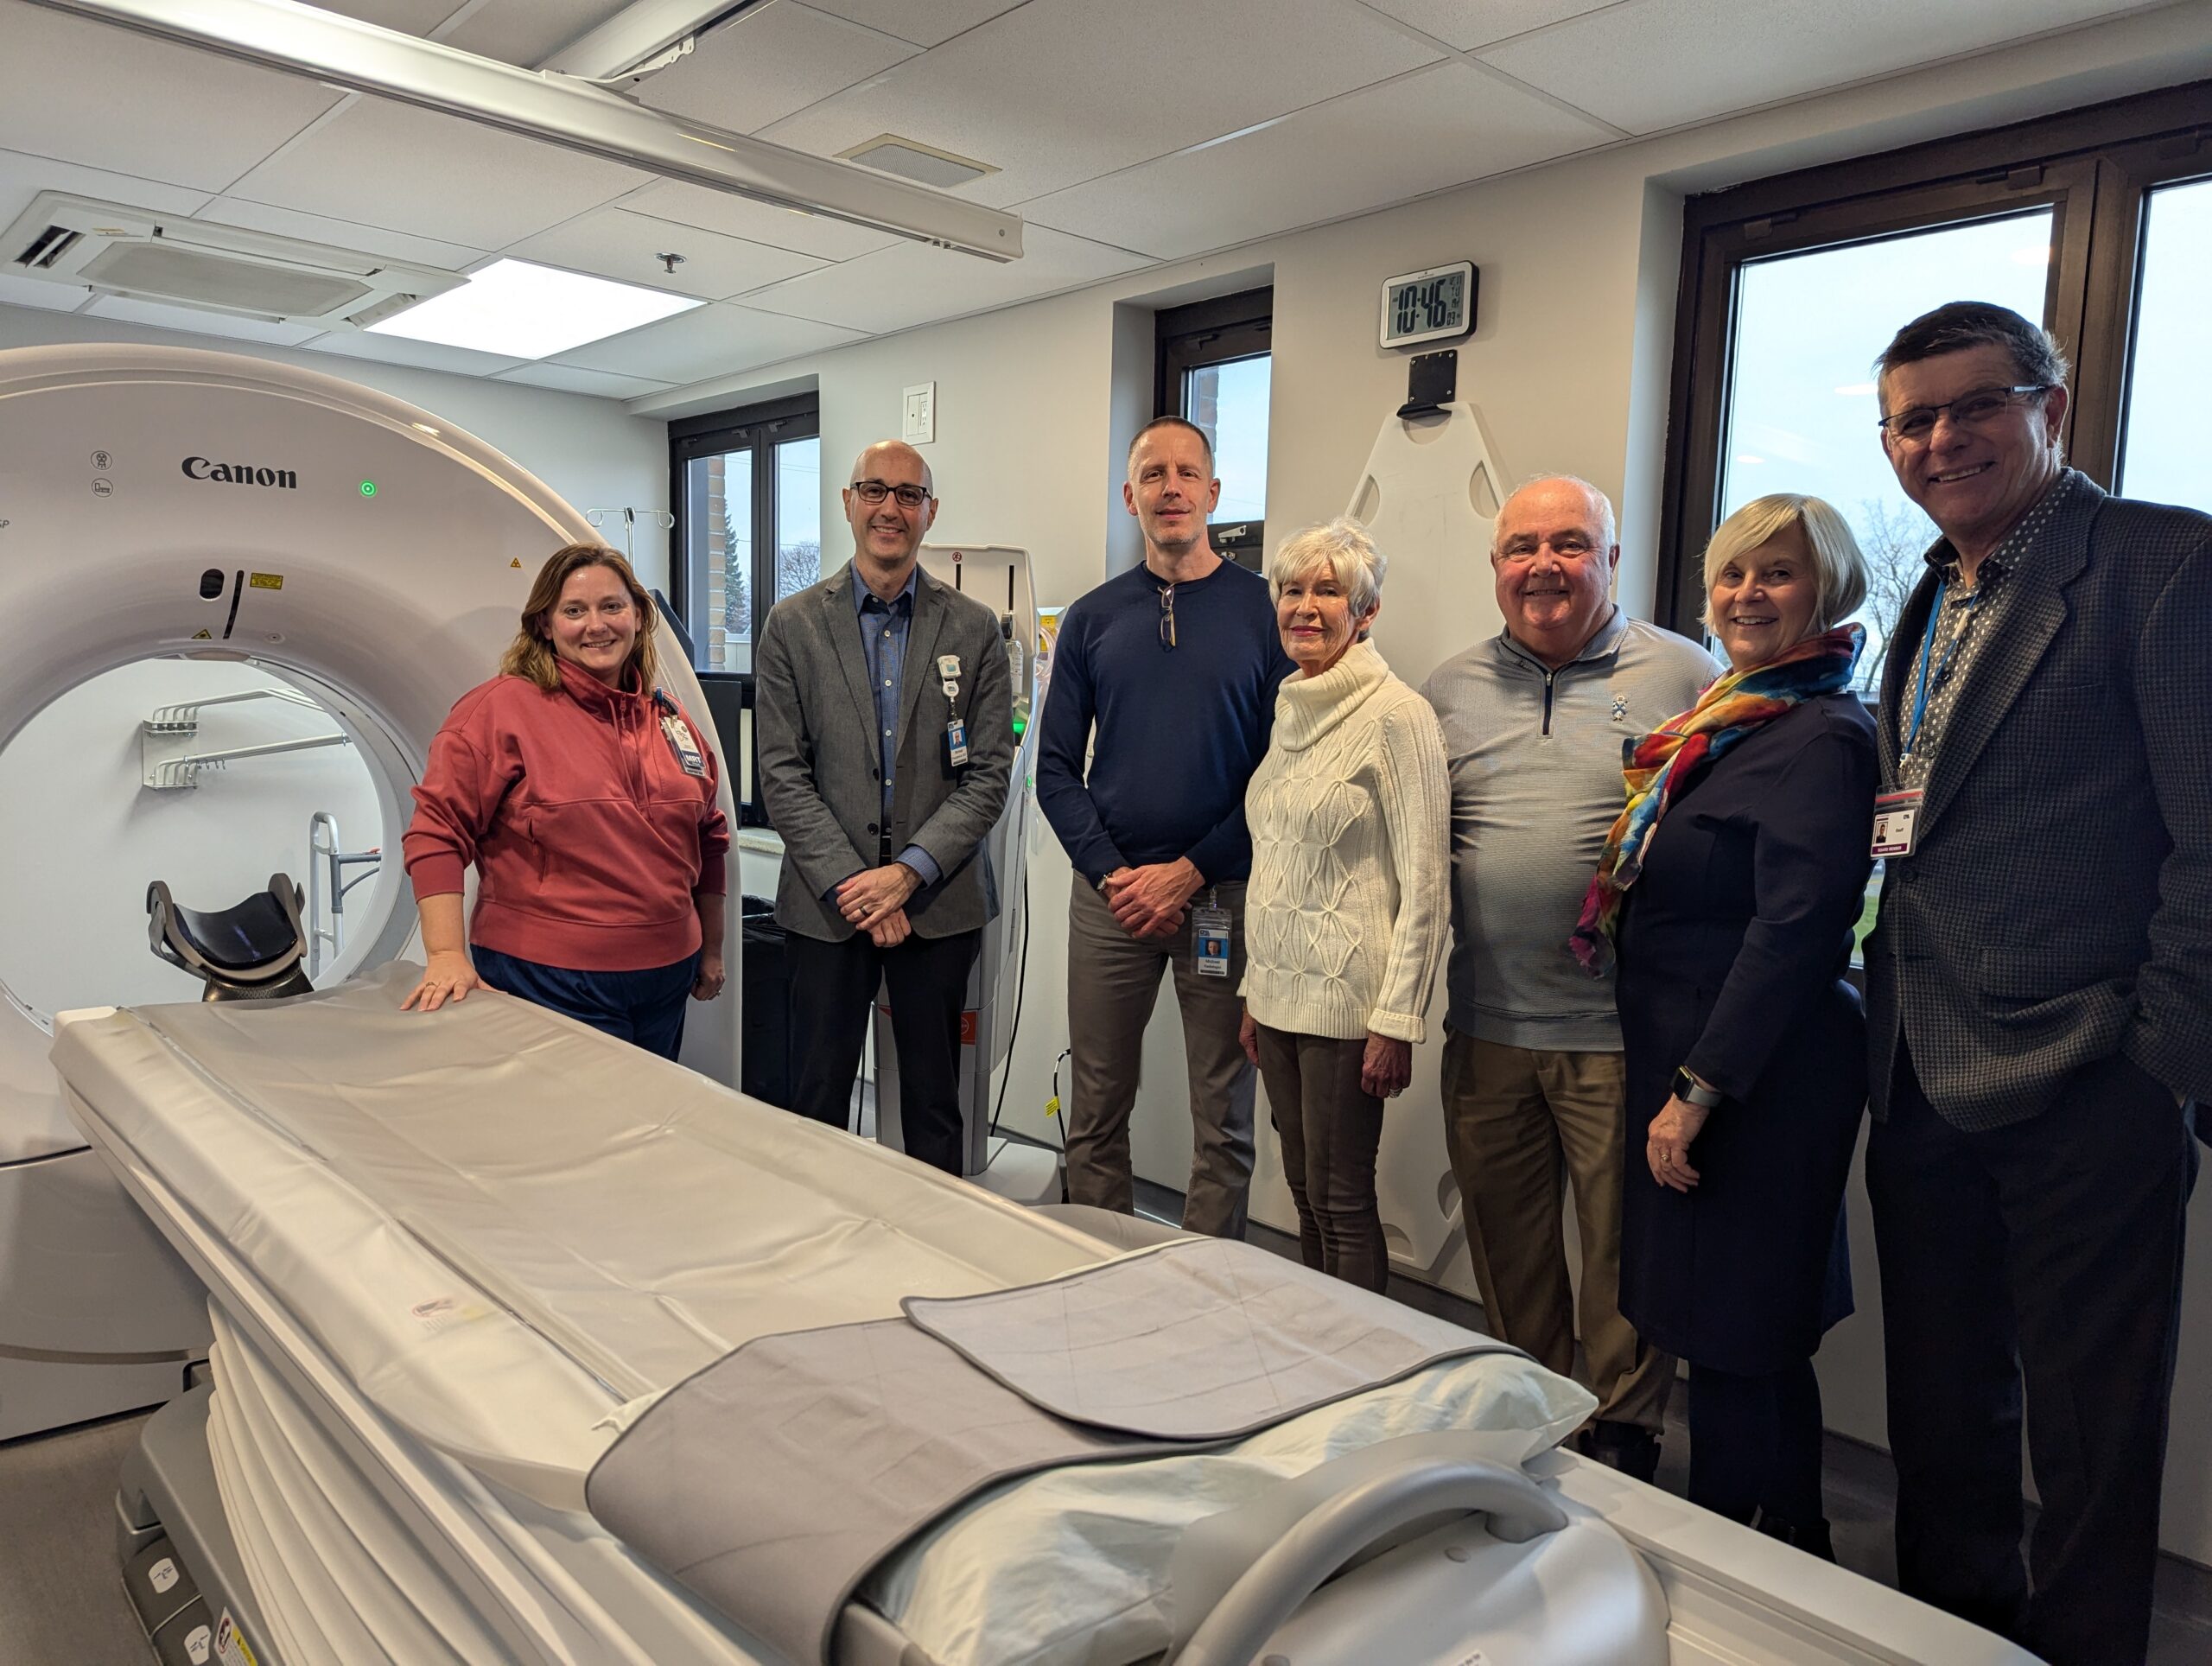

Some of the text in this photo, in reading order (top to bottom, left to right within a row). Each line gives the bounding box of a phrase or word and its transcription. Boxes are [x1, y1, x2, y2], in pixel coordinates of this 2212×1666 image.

[1396, 278, 1446, 334] 10:46
[181, 456, 296, 489] Canon
[685, 755, 702, 764] MRT
